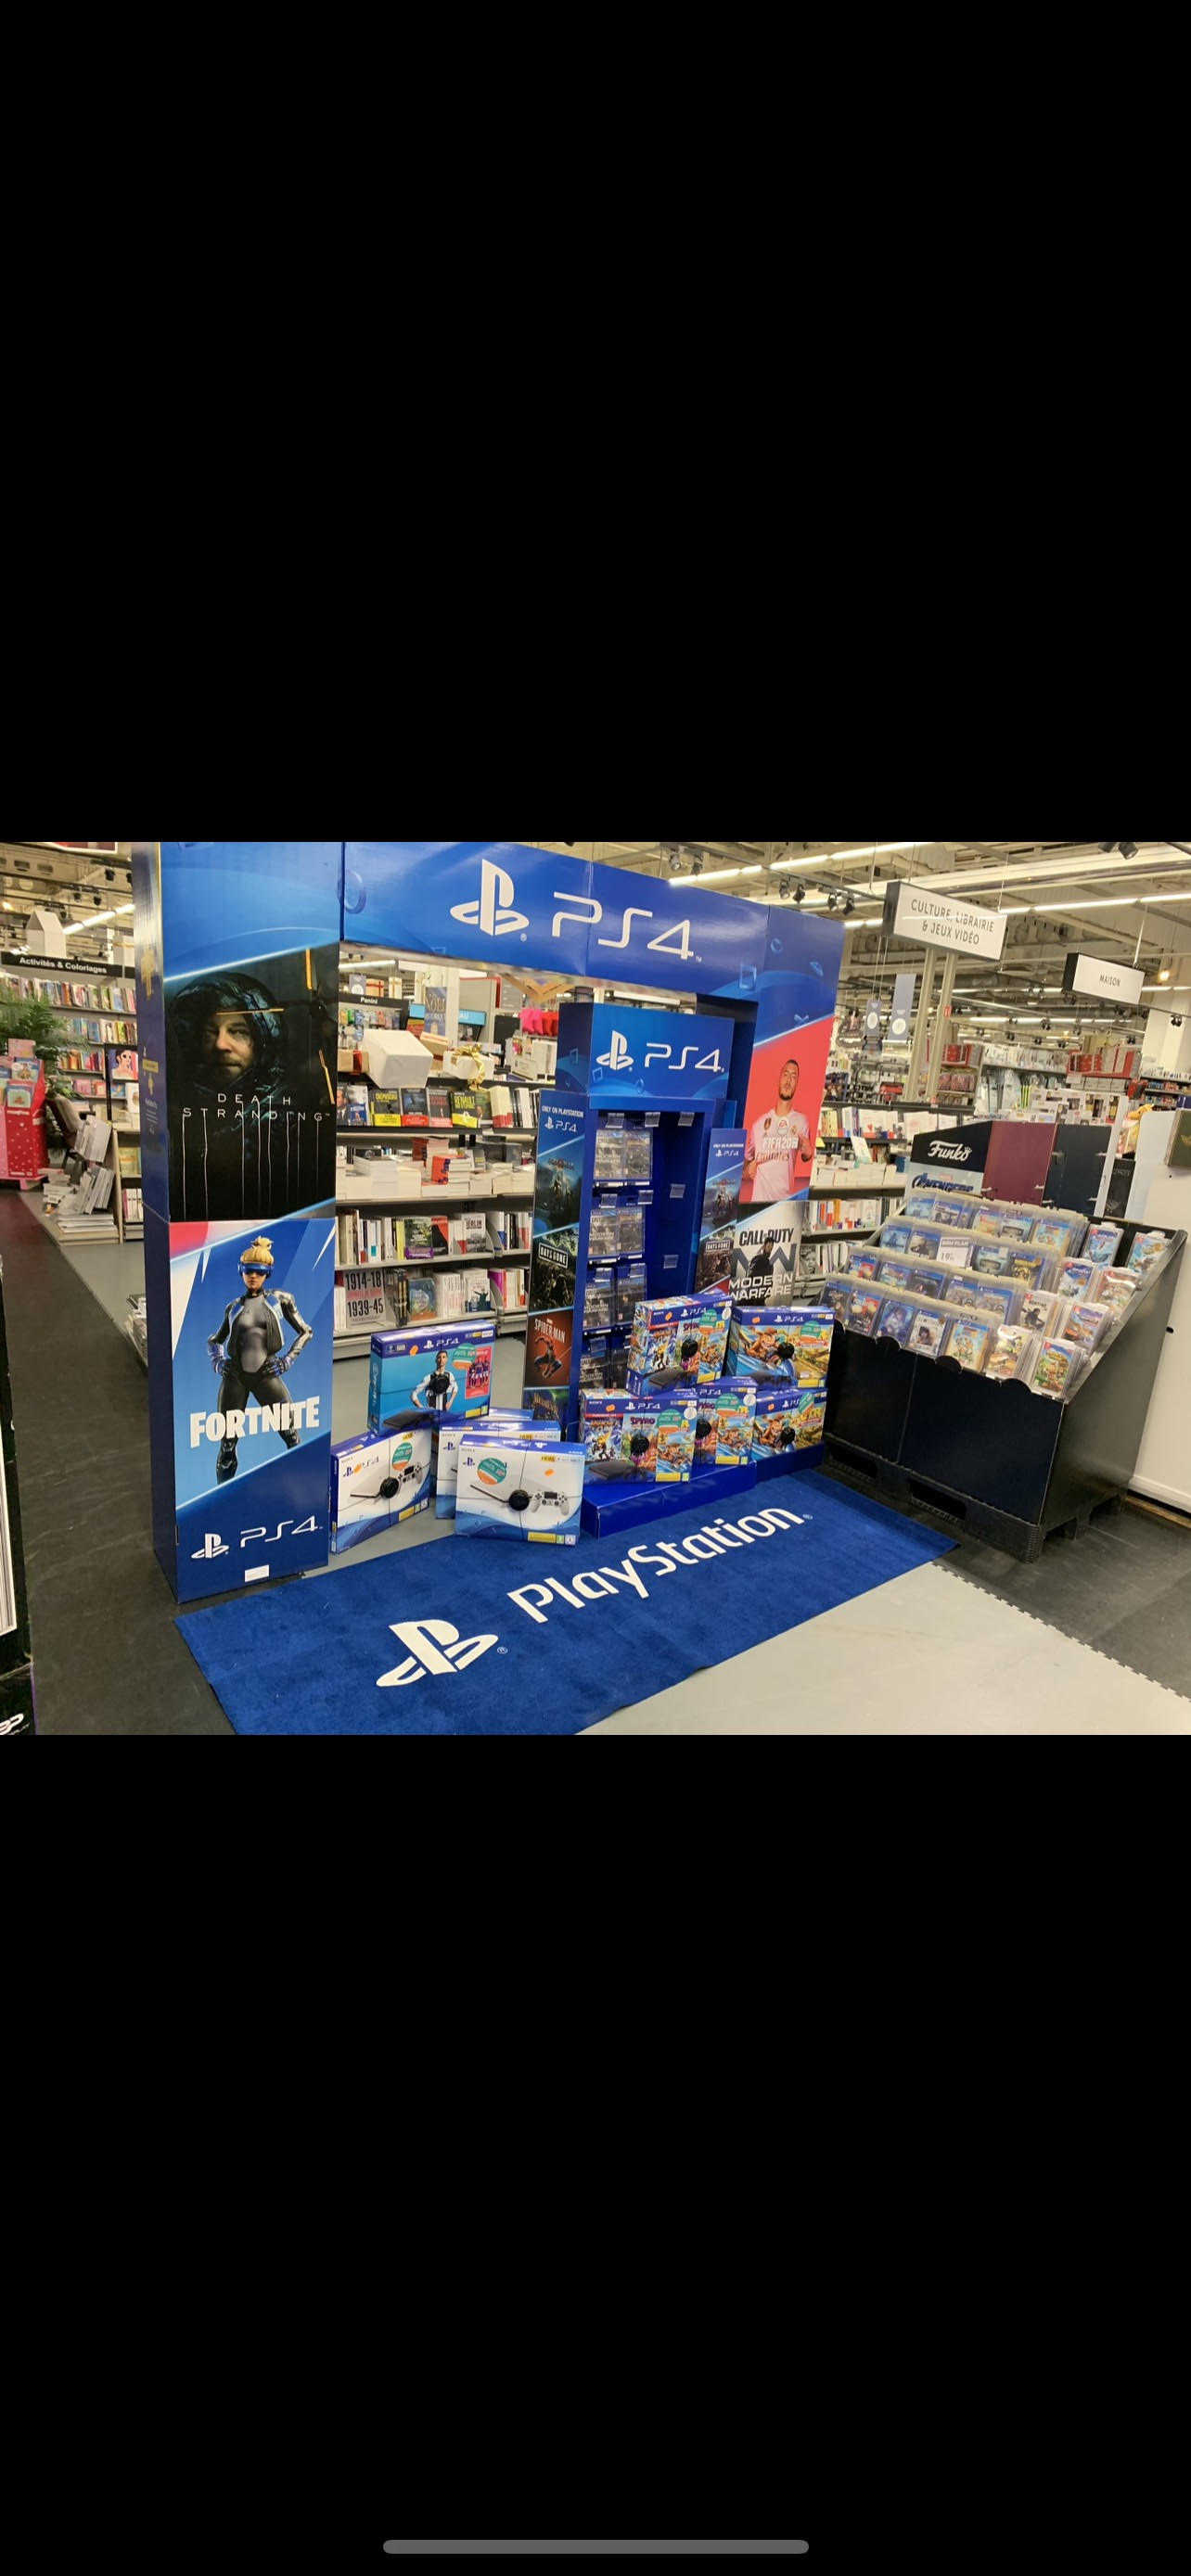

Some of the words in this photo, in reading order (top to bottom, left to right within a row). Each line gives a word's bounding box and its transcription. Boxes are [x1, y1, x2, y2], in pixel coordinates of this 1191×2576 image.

[552, 891, 694, 960] PS4
[911, 899, 953, 922] CULTURE,
[955, 912, 994, 933] LIBRAIRIE
[922, 920, 927, 932] &
[930, 923, 953, 938] JEUX
[954, 928, 980, 945] VIDÉO
[57, 961, 64, 969] &
[65, 963, 108, 975] Coloriages
[1099, 974, 1121, 988] MAISON
[645, 1042, 722, 1072] PS4
[217, 1093, 291, 1105] DEATH
[183, 1108, 323, 1122] STRANDING
[556, 1120, 577, 1132] PS4
[928, 1140, 972, 1161] Funko
[739, 1230, 763, 1246] CALL
[346, 1271, 381, 1291] 1914-18
[729, 1273, 793, 1291] MODERN
[728, 1284, 791, 1300] WARFARE
[348, 1298, 384, 1318] 1939-45
[534, 1319, 566, 1344] SPIDER-MAN
[436, 1338, 460, 1348] PS4
[637, 1401, 661, 1409] PS4
[190, 1396, 320, 1448] FORTNITE
[240, 1515, 319, 1548] PS4
[506, 1508, 805, 1624] PlayStation
